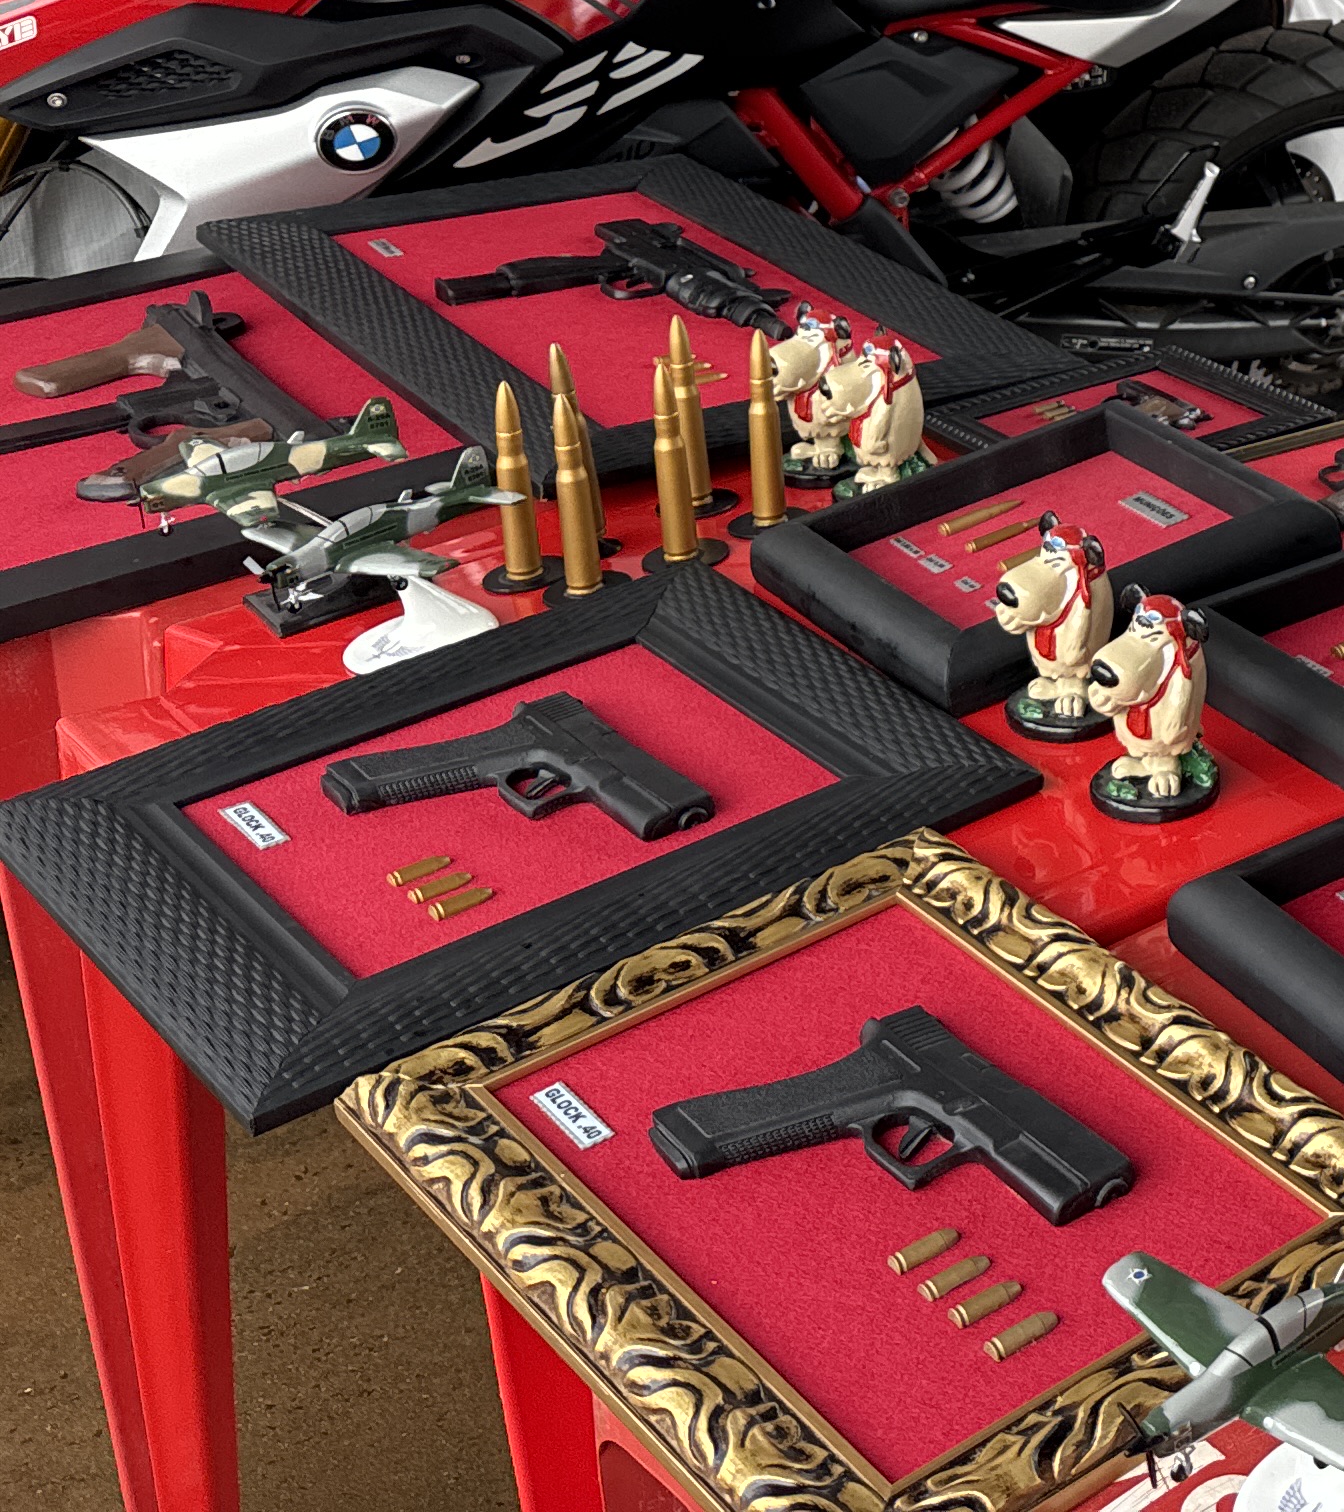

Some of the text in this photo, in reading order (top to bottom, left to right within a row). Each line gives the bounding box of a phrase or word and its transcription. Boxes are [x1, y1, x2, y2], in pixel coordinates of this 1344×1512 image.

[233, 806, 276, 843] GLOCK .40
[544, 1087, 602, 1140] GLOCK .40
